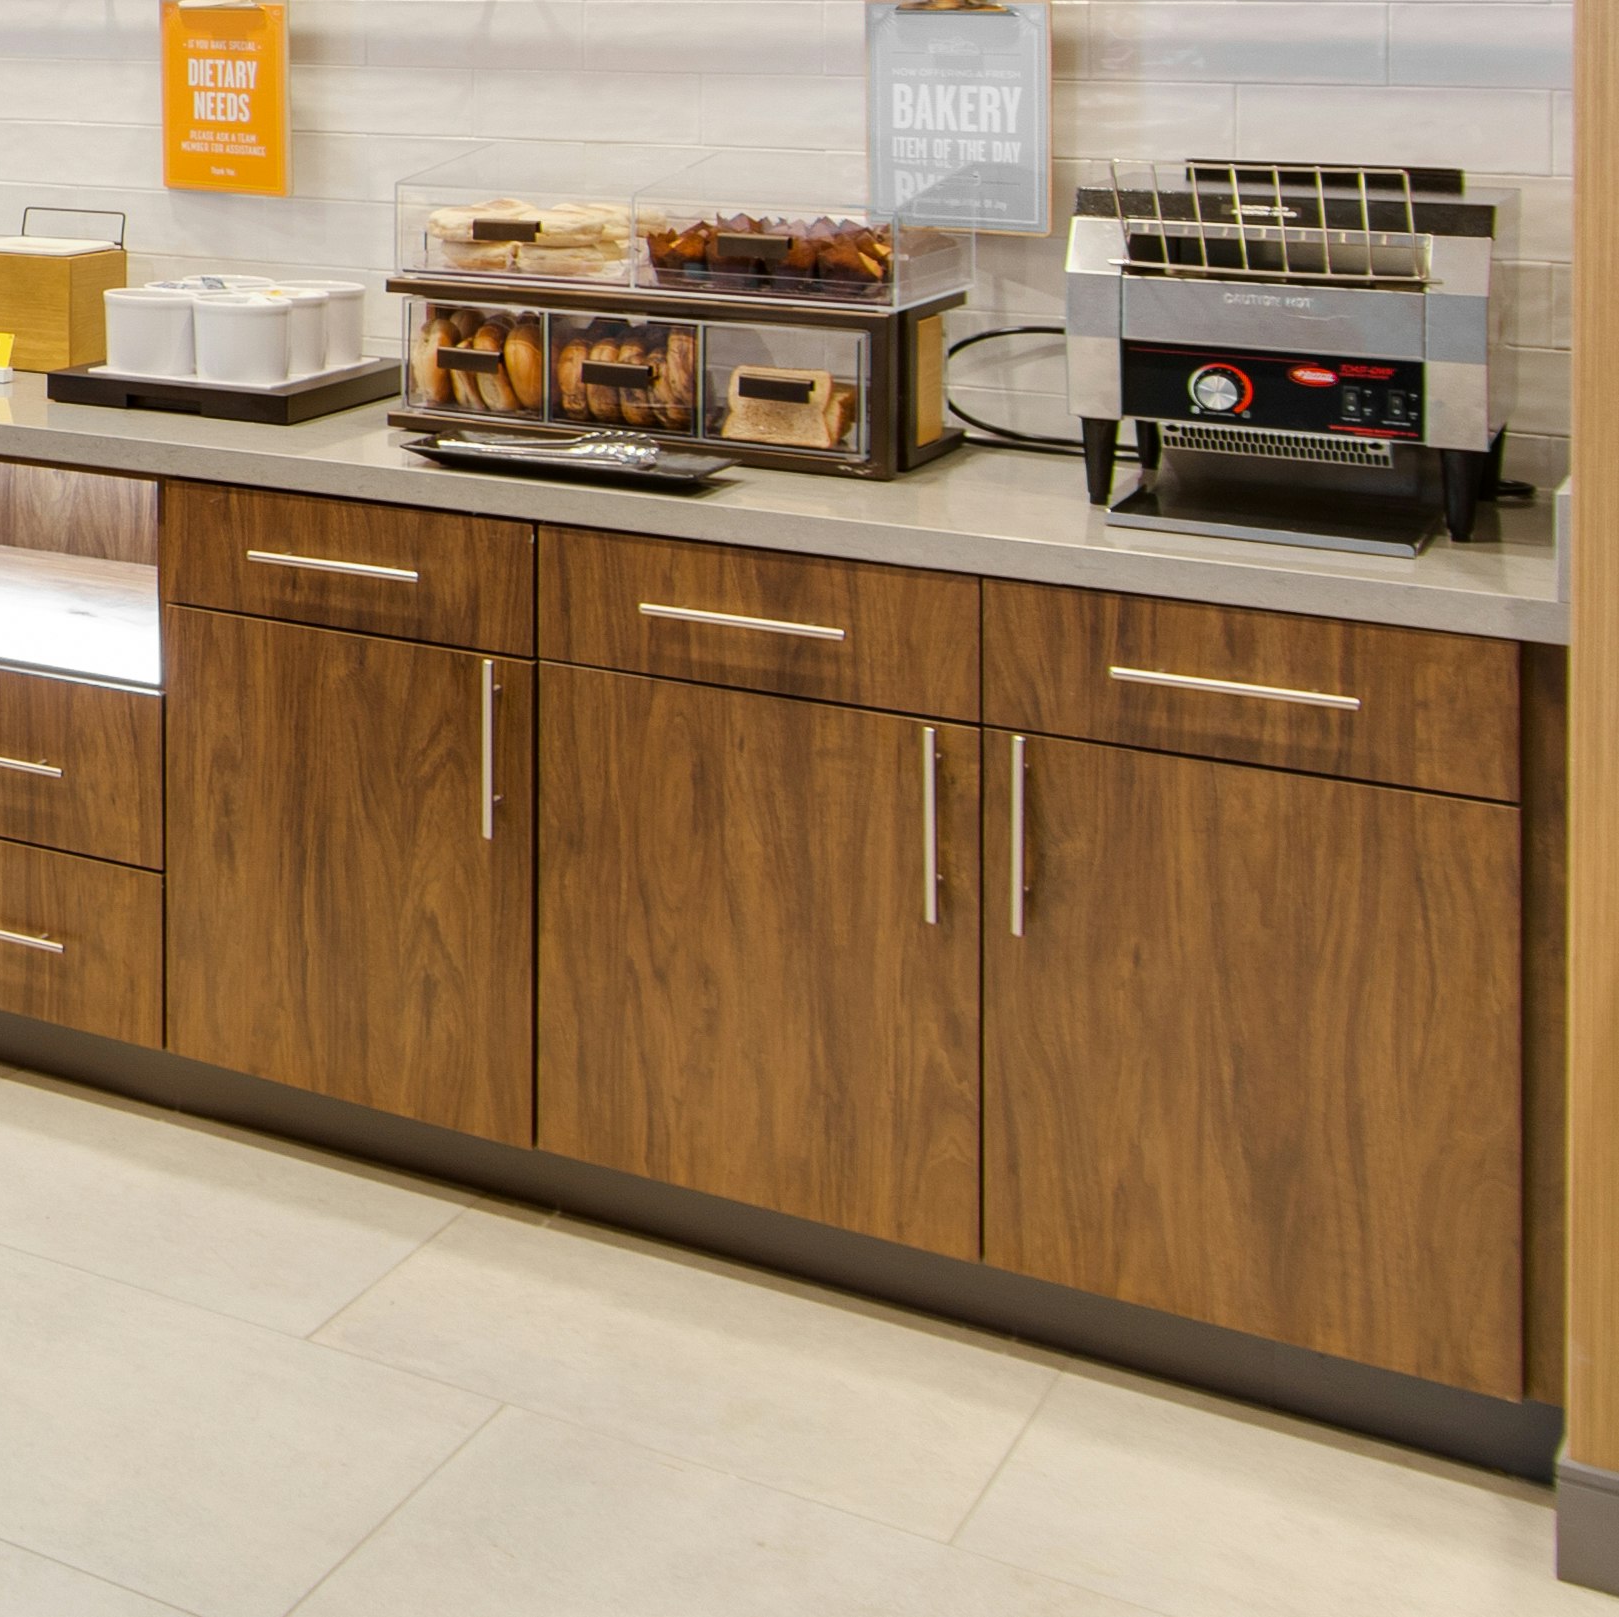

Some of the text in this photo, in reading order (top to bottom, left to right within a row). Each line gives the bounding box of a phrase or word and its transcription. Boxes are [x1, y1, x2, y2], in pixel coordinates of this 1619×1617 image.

[229, 40, 257, 52] SPECIAL
[187, 58, 258, 89] DIETARY
[985, 70, 1022, 80] FRESH
[193, 90, 251, 123] NEEDS
[892, 83, 1023, 135] BAKERY
[893, 136, 1022, 164] ITEM OF THE DAY
